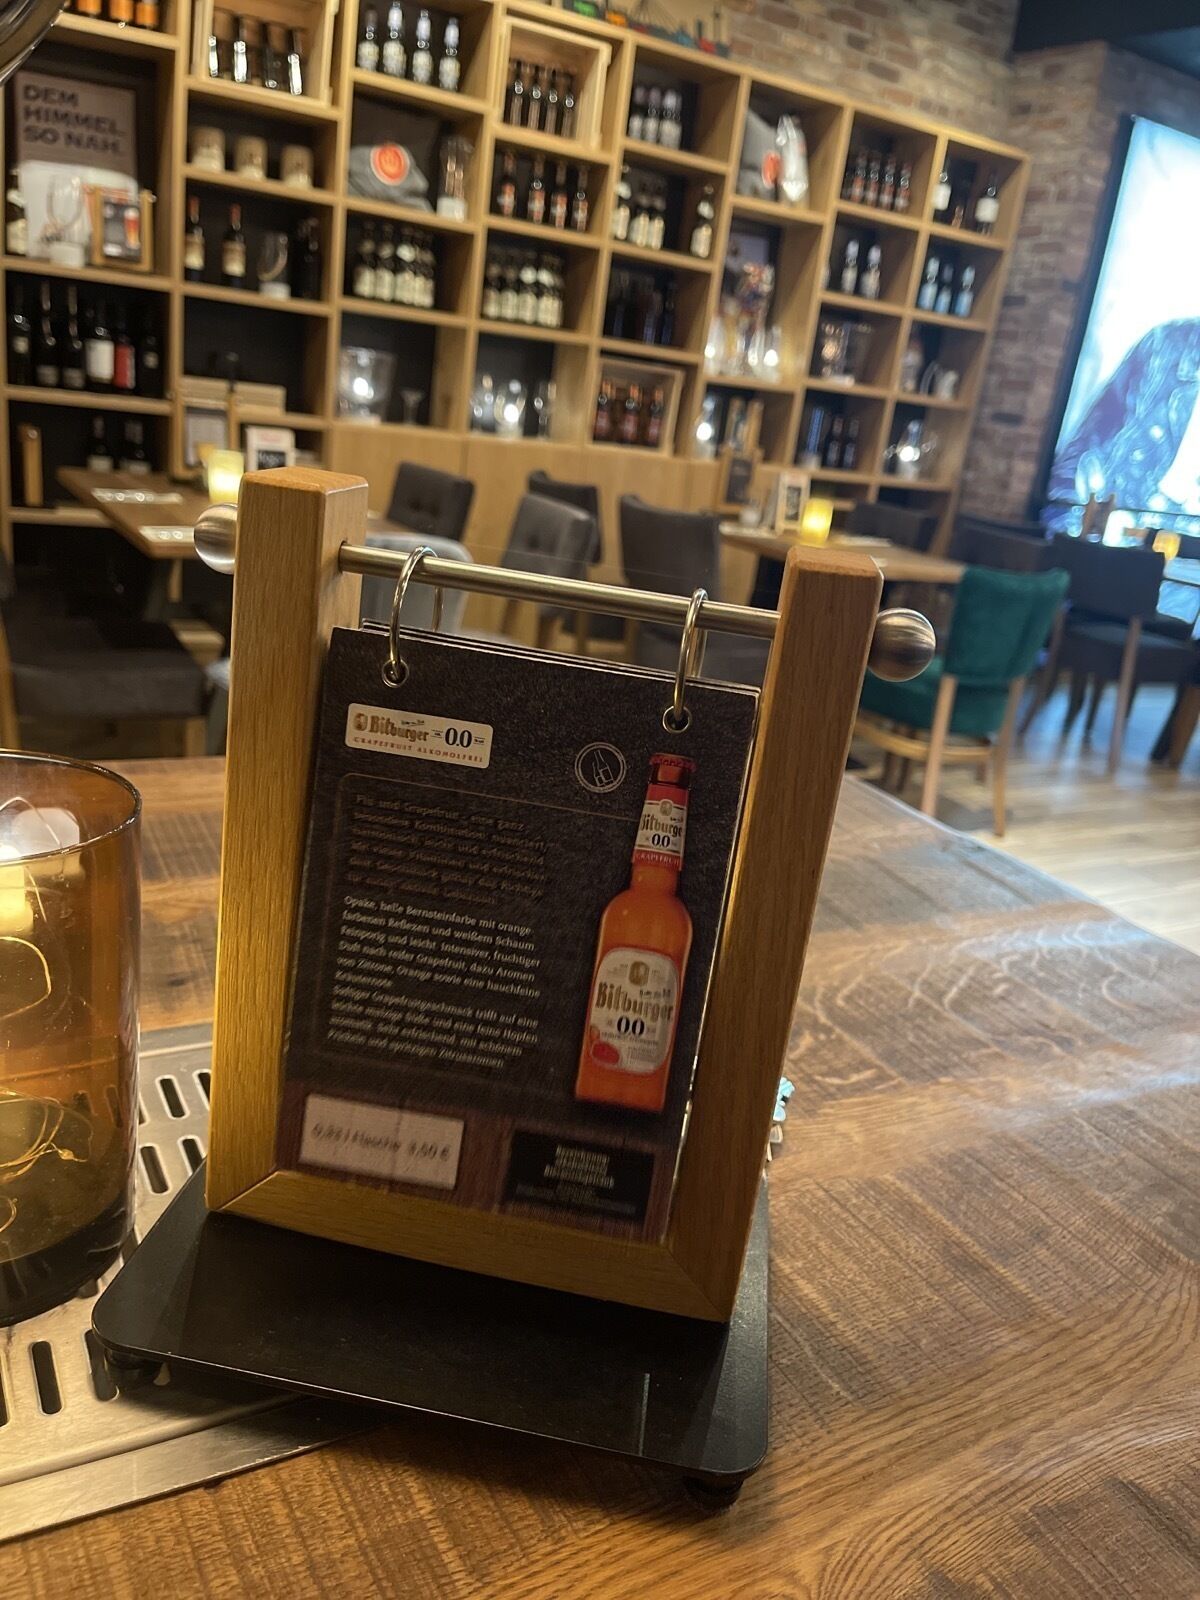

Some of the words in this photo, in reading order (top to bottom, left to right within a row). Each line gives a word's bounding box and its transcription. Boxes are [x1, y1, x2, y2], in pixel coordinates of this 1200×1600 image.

[23, 85, 78, 107] DEM
[23, 125, 59, 145] SO
[370, 715, 430, 742] Bitburger
[354, 736, 413, 751] GRAPEFRUIT
[417, 746, 483, 763] ALKOHOLFREI
[379, 900, 403, 913] helle
[405, 905, 475, 926] Bernsteinfarbe
[477, 918, 494, 929] mit
[431, 924, 450, 937] und
[387, 932, 406, 944] und
[491, 950, 538, 969] fruchtiger
[463, 976, 483, 988] eine
[494, 966, 534, 982] Aromen
[595, 981, 673, 1023] Bitburger
[498, 1011, 514, 1024] auf
